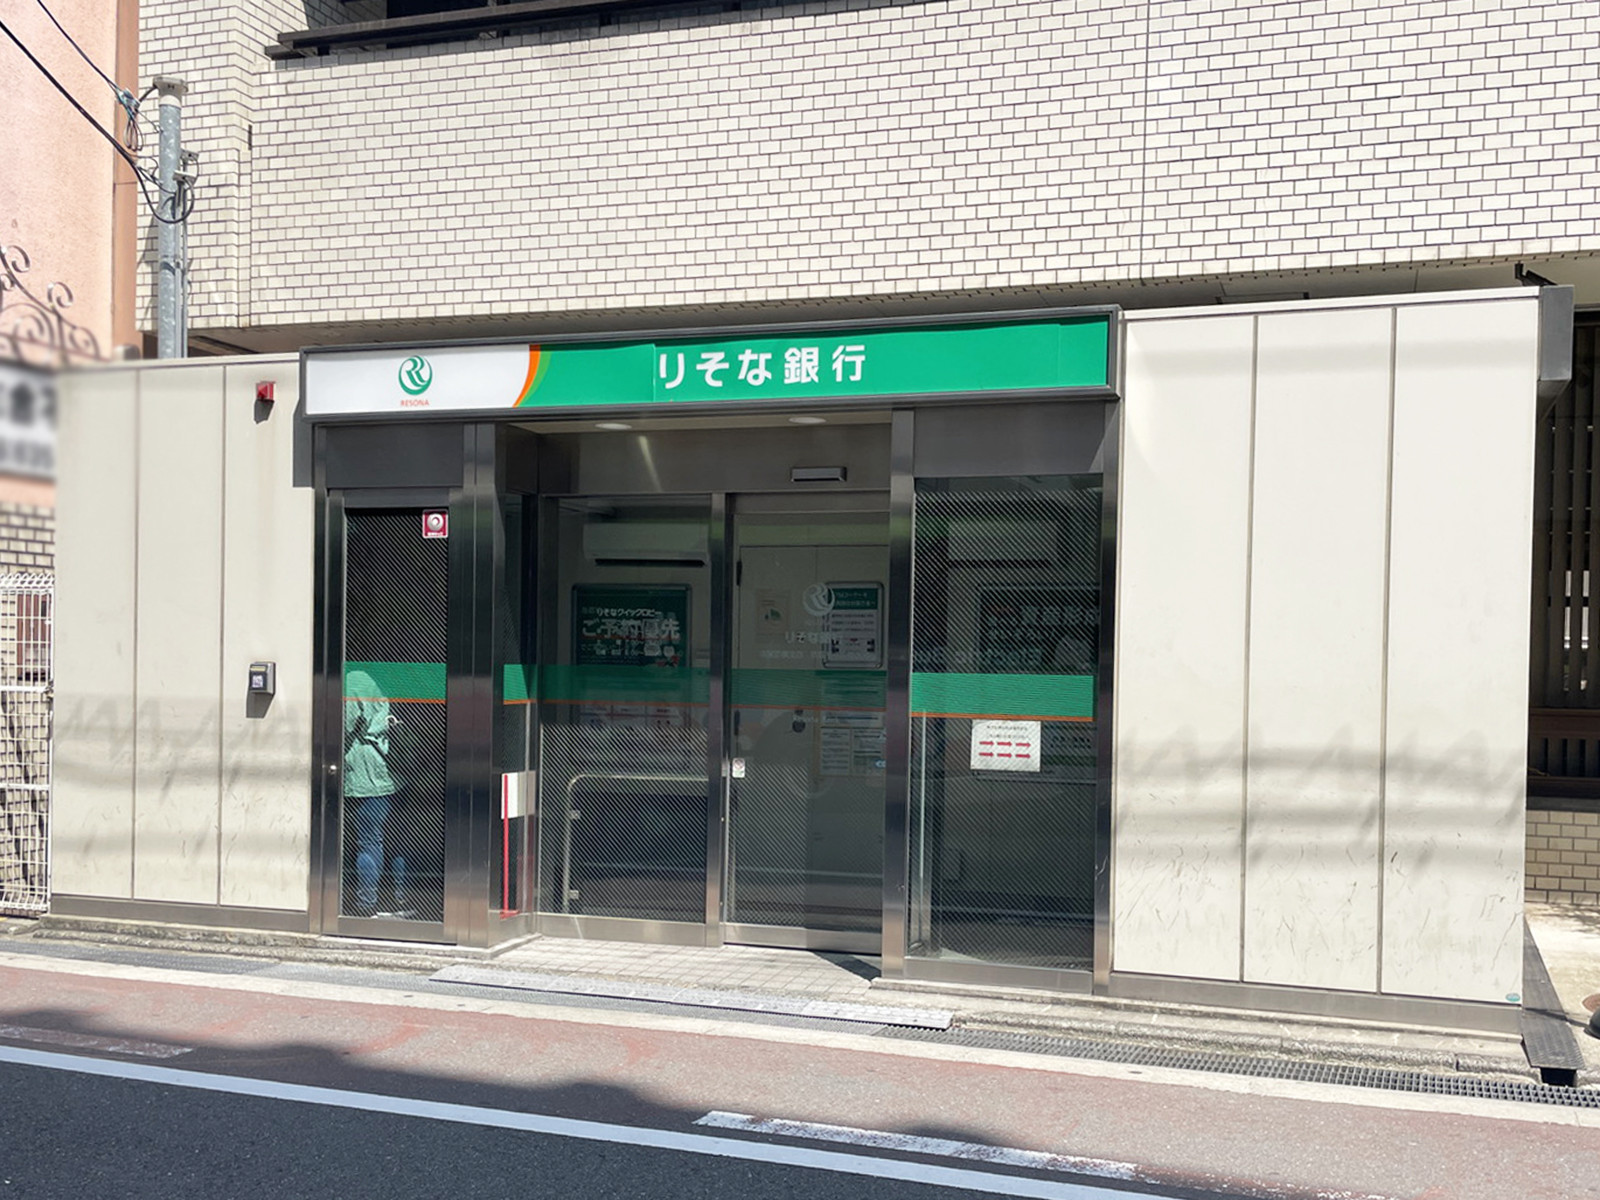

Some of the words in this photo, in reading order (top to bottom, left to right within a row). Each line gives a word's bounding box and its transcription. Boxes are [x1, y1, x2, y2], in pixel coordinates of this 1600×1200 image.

[659, 345, 866, 389] りそな銀行
[400, 399, 430, 407] RESONA
